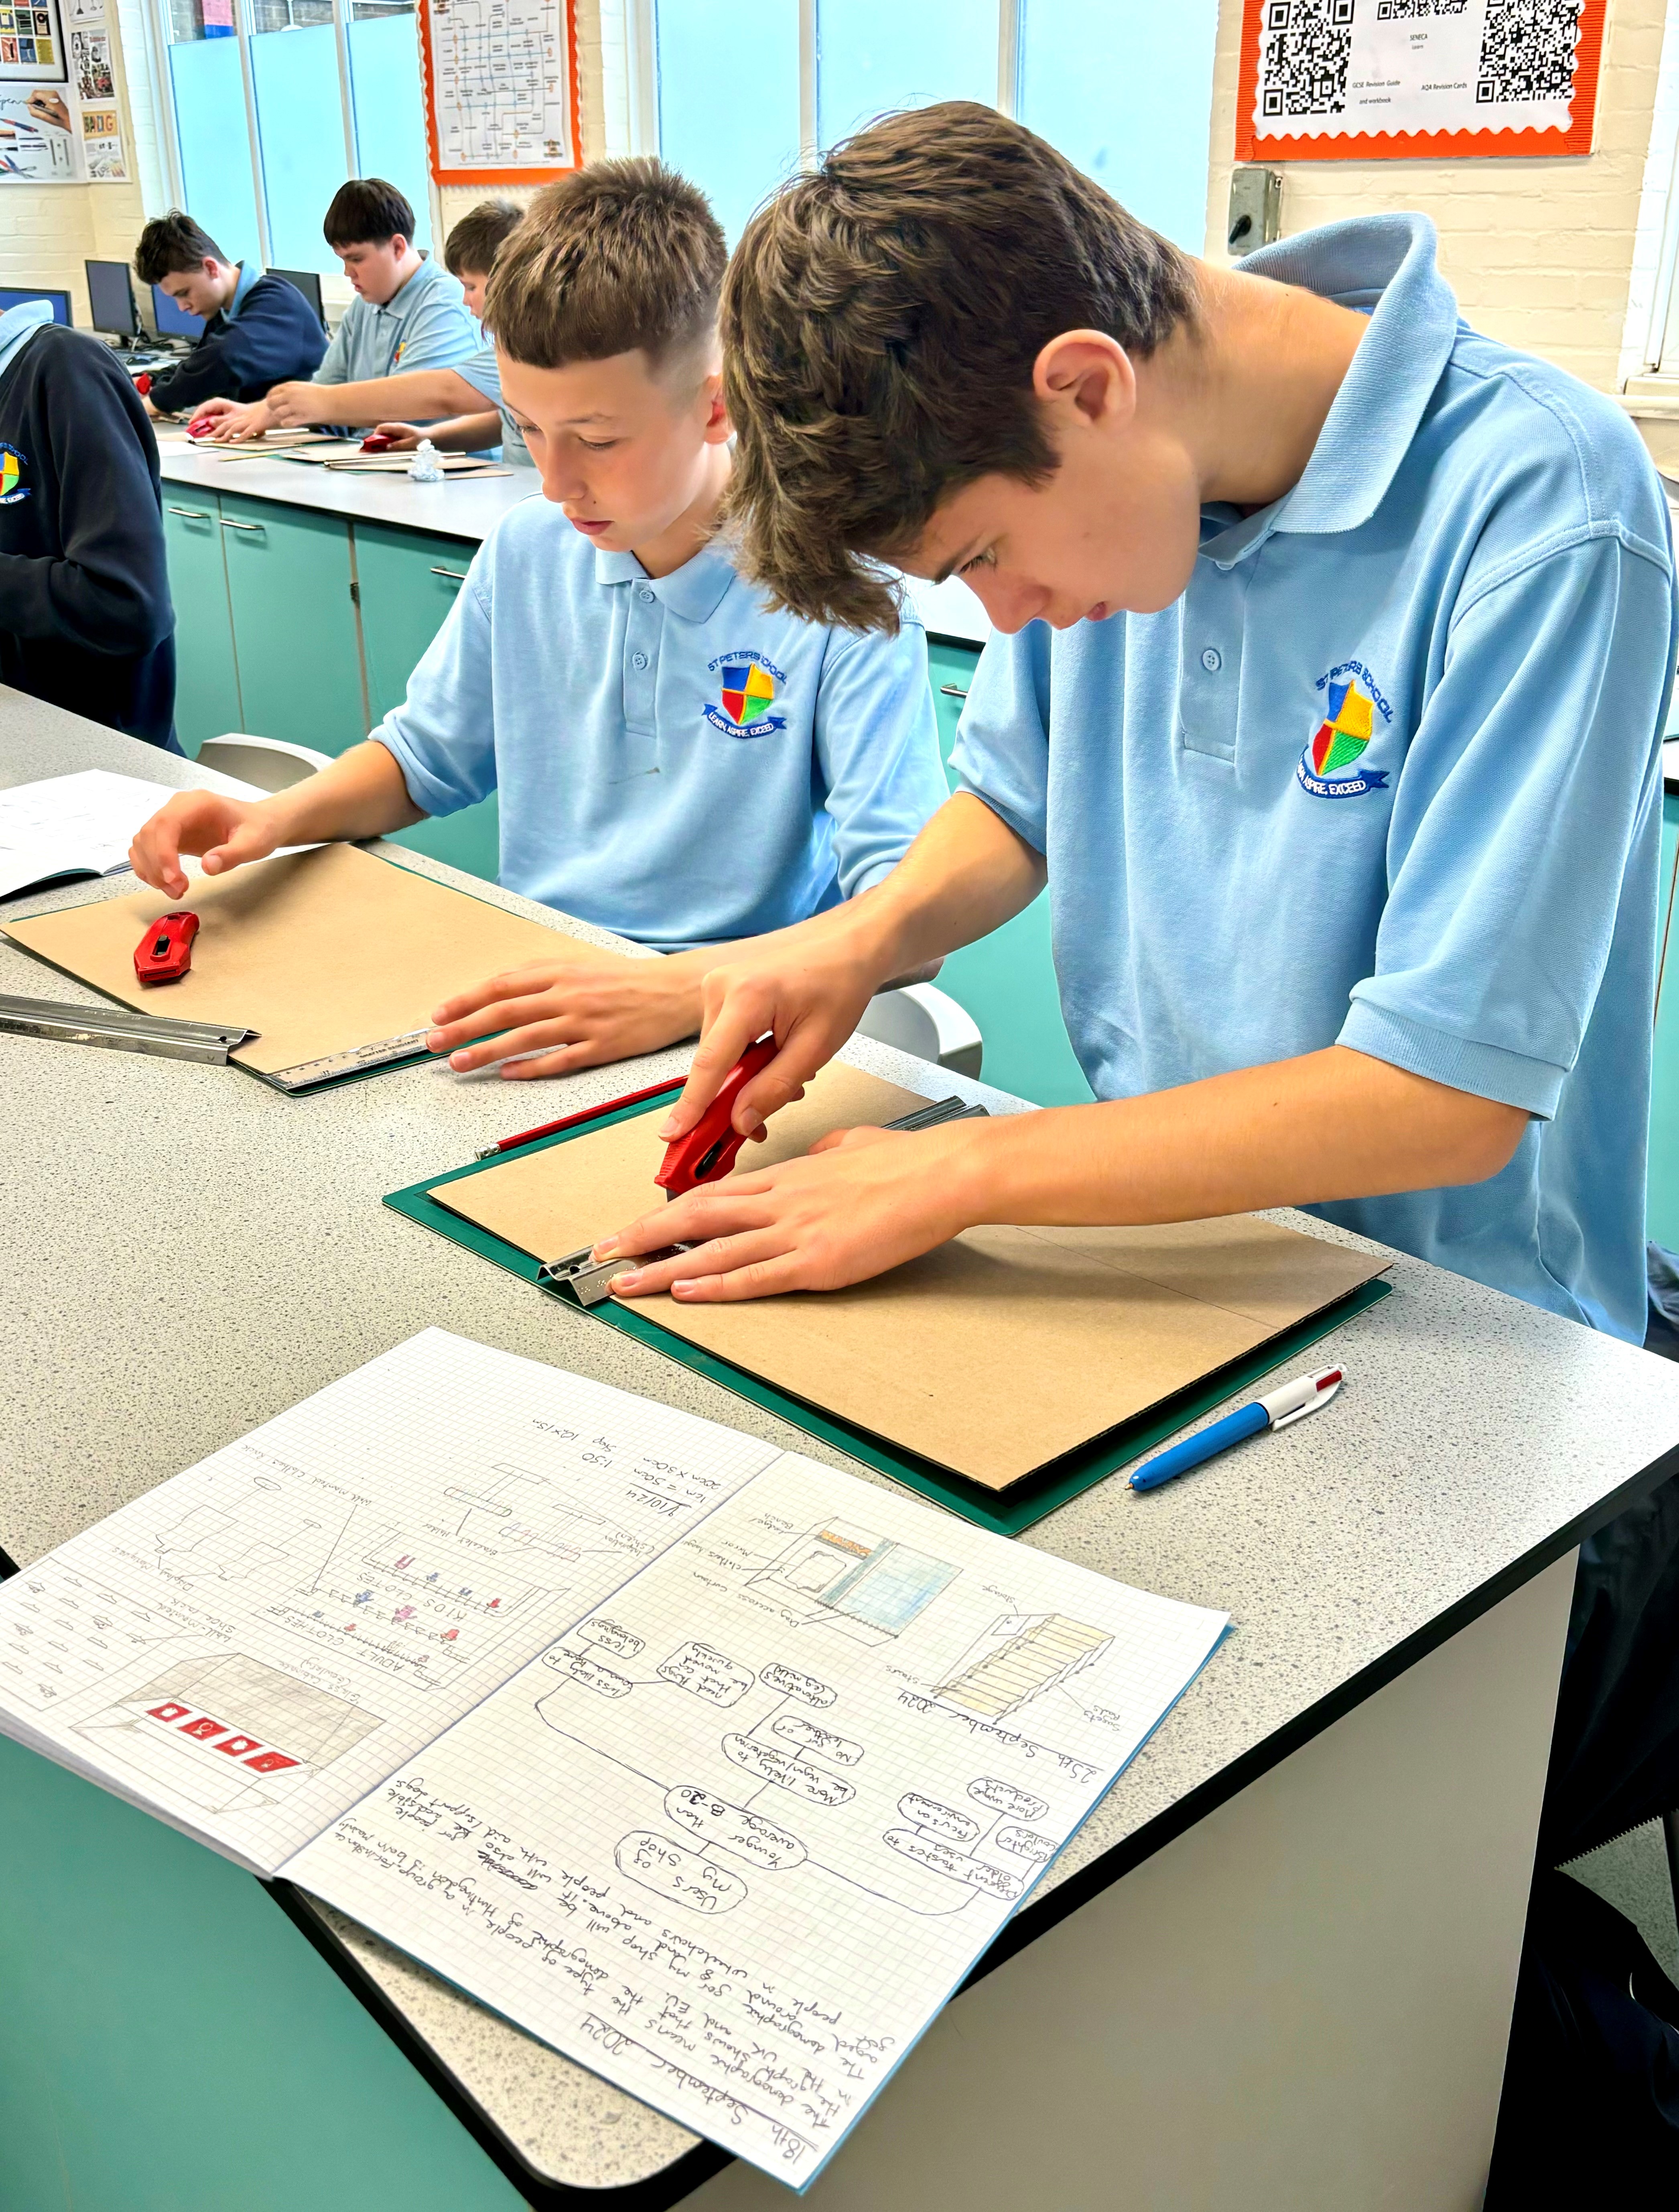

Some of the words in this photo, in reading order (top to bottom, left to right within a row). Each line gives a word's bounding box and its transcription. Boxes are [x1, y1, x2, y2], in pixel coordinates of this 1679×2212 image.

[719, 651, 761, 665] PETERS
[760, 656, 788, 685] SCHOOL
[1362, 667, 1394, 724] SCHOOL
[750, 723, 774, 736] EXCEED
[1328, 780, 1366, 795] EXCEED
[592, 1437, 616, 1452] Shop
[582, 1453, 612, 1468] 1:50
[643, 1458, 677, 1473] 30cm
[634, 1468, 666, 1485] 50cm
[692, 1474, 721, 1489] 20cm
[626, 1490, 679, 1517] 9/10/24
[686, 1490, 706, 1503] 1cm
[284, 1616, 344, 1645] CLOTHES
[356, 1649, 404, 1671] ADULT
[897, 1688, 935, 1713] 2024
[948, 1710, 1038, 1757] September
[1058, 1754, 1096, 1783] 25th
[395, 1800, 437, 1831] people
[638, 1837, 681, 1866] Shop
[561, 1869, 610, 1898] people
[672, 1876, 717, 1910] Users
[583, 1899, 631, 1930] above.
[486, 1914, 537, 1948] people
[622, 1938, 657, 1960] shop
[662, 1929, 747, 1978] wheelchairs
[668, 1956, 690, 1977] my
[700, 1969, 714, 1980] 8
[611, 1997, 631, 2015] the
[622, 1985, 643, 2005] the
[665, 1992, 690, 2013] EU.
[792, 1998, 842, 2024] people
[580, 2015, 633, 2055] 2024
[751, 2042, 777, 2062] UK
[832, 2034, 877, 2062] aged
[802, 2068, 823, 2089] the
[841, 2057, 863, 2079] The
[651, 2062, 747, 2124] September
[802, 2104, 829, 2127] The
[819, 2096, 839, 2115] the
[772, 2125, 810, 2163] 18th
